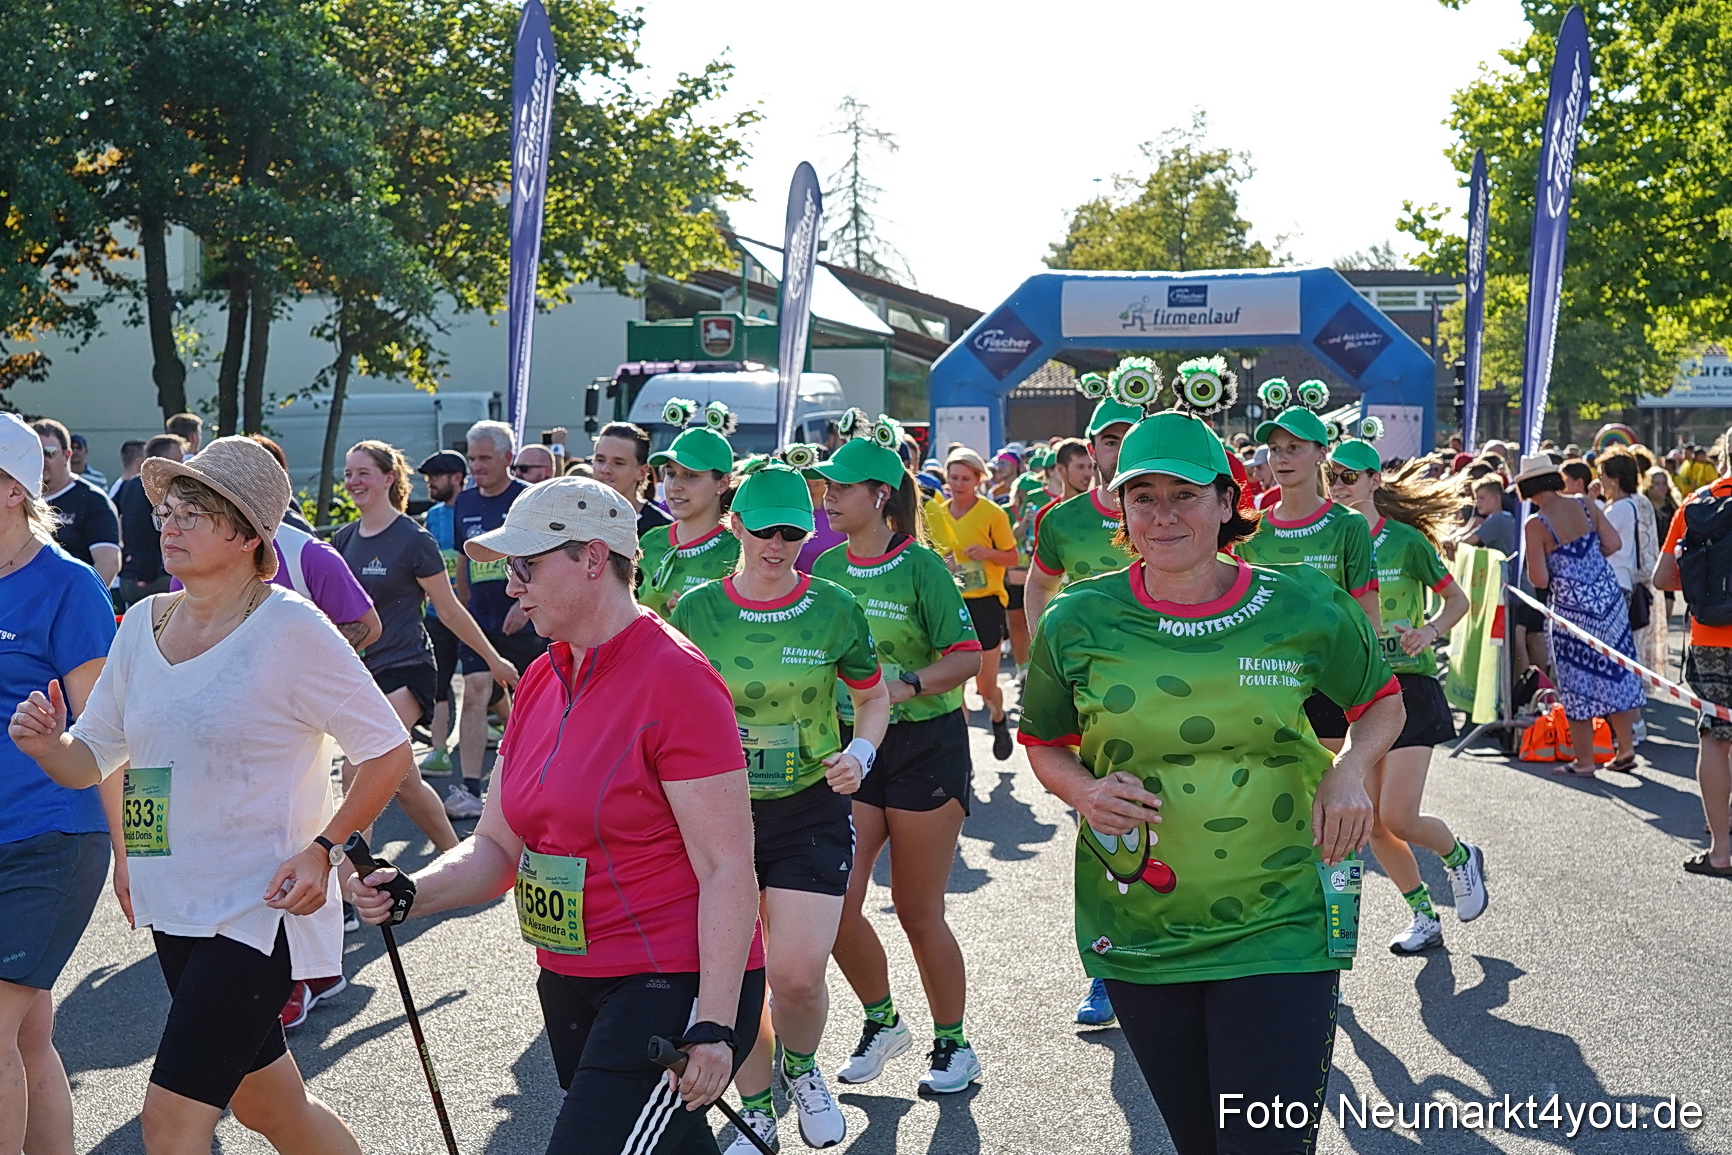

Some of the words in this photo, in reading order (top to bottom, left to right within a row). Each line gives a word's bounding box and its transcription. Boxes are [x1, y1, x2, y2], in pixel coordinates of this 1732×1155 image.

[1553, 51, 1581, 192] Fischer
[1153, 306, 1242, 325] firmenlauf
[1274, 516, 1331, 539] MONSTERSTARK
[846, 554, 906, 578] MONSTERSTARK
[738, 595, 815, 623] MONSTERSTARK
[866, 598, 909, 614] TRENDHAUS
[1157, 585, 1275, 637] MONSTERSTARK
[782, 646, 827, 659] TRENDHAUS
[1237, 656, 1304, 676] TRENDHAUS
[1239, 674, 1301, 688] POWER-TEAM
[748, 771, 786, 779] Dominika
[785, 751, 795, 782] 2022
[155, 803, 165, 843] 2022
[136, 830, 152, 840] Doris
[518, 878, 565, 921] 1580
[528, 916, 566, 936] Alexandra
[567, 897, 579, 942] 2022
[1331, 904, 1341, 938] RUN
